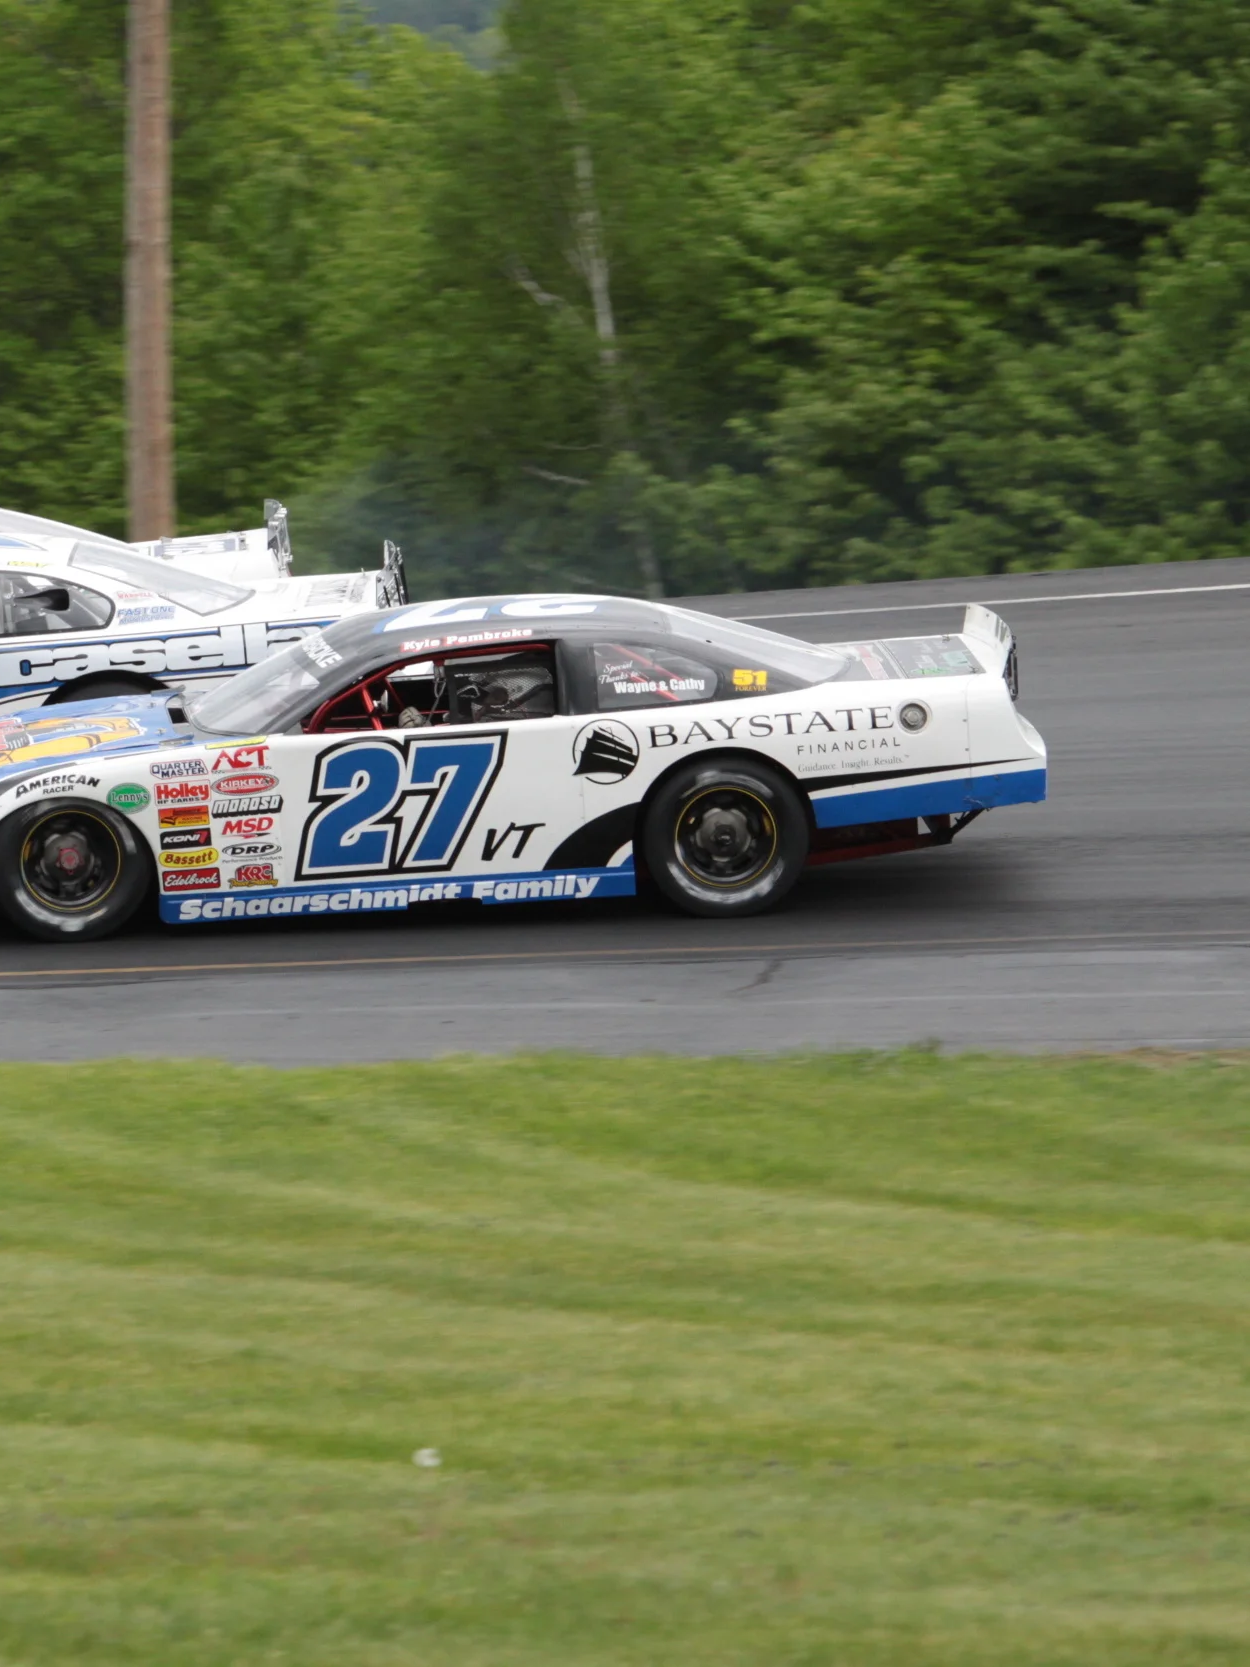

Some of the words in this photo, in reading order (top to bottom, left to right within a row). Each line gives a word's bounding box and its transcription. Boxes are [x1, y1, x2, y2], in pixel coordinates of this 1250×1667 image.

[117, 607, 148, 618] FAST
[149, 606, 177, 614] ONE
[402, 638, 441, 651] Kyle
[446, 628, 533, 645] Pembroke
[603, 660, 634, 675] Special
[600, 672, 628, 685] Thanks
[732, 668, 768, 686] 51
[613, 680, 657, 694] Wayne
[658, 680, 668, 691] &
[670, 678, 705, 691] Cathy
[646, 705, 895, 749] BAYSTATE
[797, 737, 902, 756] FINANCIAL
[212, 746, 270, 771] ACT
[152, 760, 201, 774] QUARTER
[161, 767, 206, 779] MASTER
[14, 774, 102, 799] AMERICAN
[42, 784, 75, 795] RACER
[155, 781, 210, 801] Holley
[220, 777, 265, 789] KIRKEY
[110, 791, 148, 804] Lenny's
[171, 796, 201, 804] CARBS
[212, 795, 283, 816] MOROSO
[294, 728, 509, 882] 27
[221, 817, 274, 836] MSD
[162, 834, 200, 844] KONI
[480, 822, 546, 861] VT
[164, 850, 213, 865] Bassett
[230, 844, 275, 856] DRP
[164, 872, 219, 888] Edelbrock
[236, 864, 273, 882] KRC
[178, 882, 462, 921] Schaarschmidt
[472, 874, 601, 902] Family
